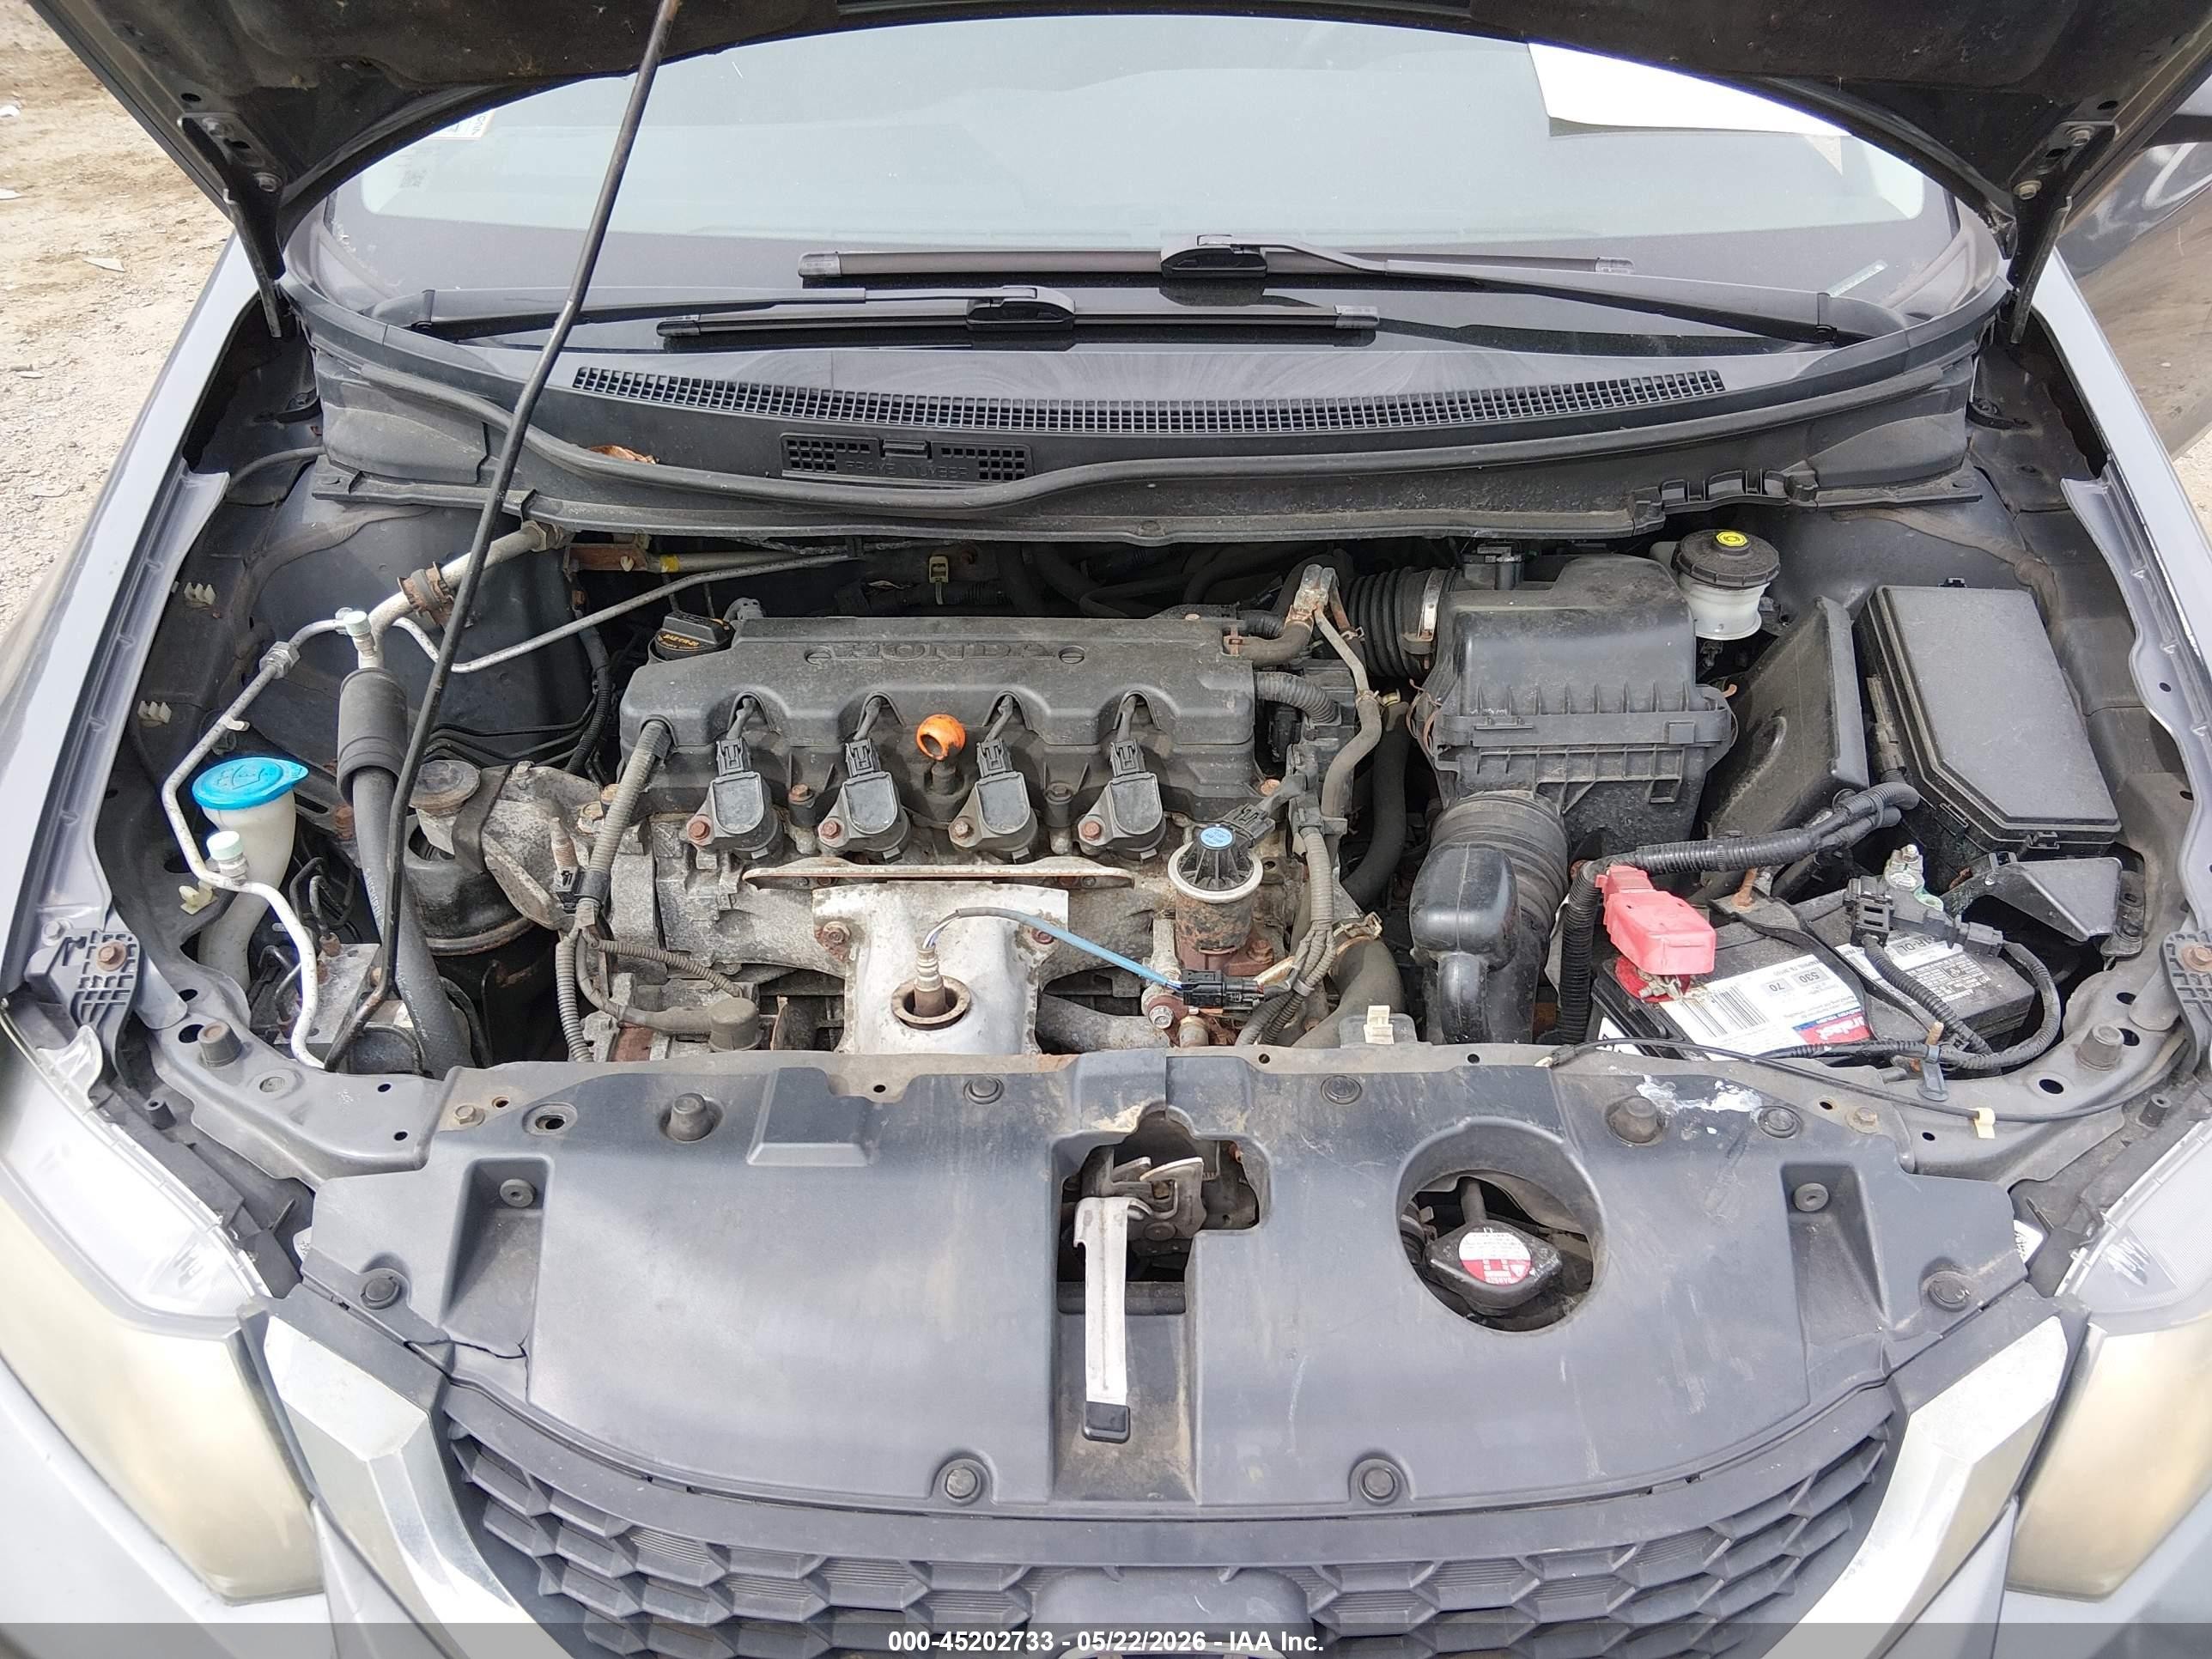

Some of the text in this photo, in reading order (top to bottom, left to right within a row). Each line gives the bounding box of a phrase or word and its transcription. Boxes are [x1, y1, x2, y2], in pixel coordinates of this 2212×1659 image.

[845, 460, 969, 478] FRAME NUMBER
[835, 641, 1055, 662] HONDA
[1799, 971, 1820, 983] 530
[1769, 981, 1785, 992] 70
